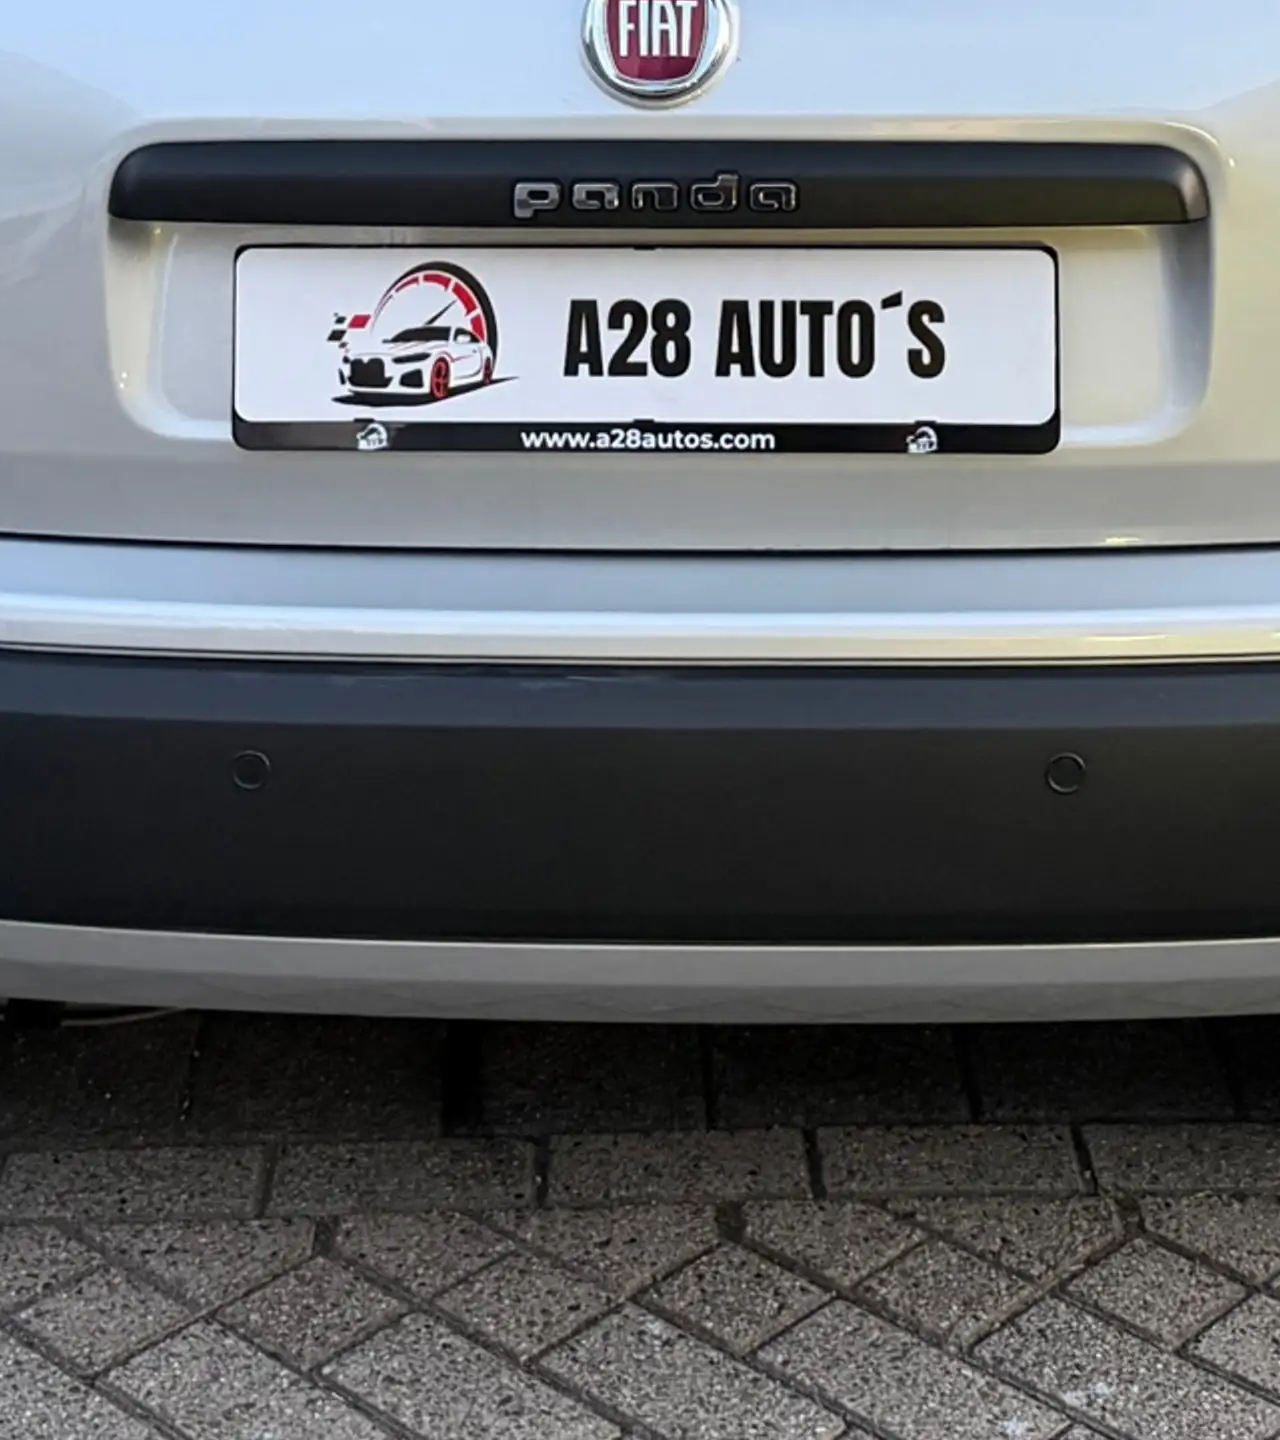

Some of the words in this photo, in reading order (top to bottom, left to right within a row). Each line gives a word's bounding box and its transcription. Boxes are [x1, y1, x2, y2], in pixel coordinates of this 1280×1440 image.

[513, 172, 798, 220] panda
[563, 298, 691, 378] A28
[520, 428, 776, 450] www.a28autos.com
